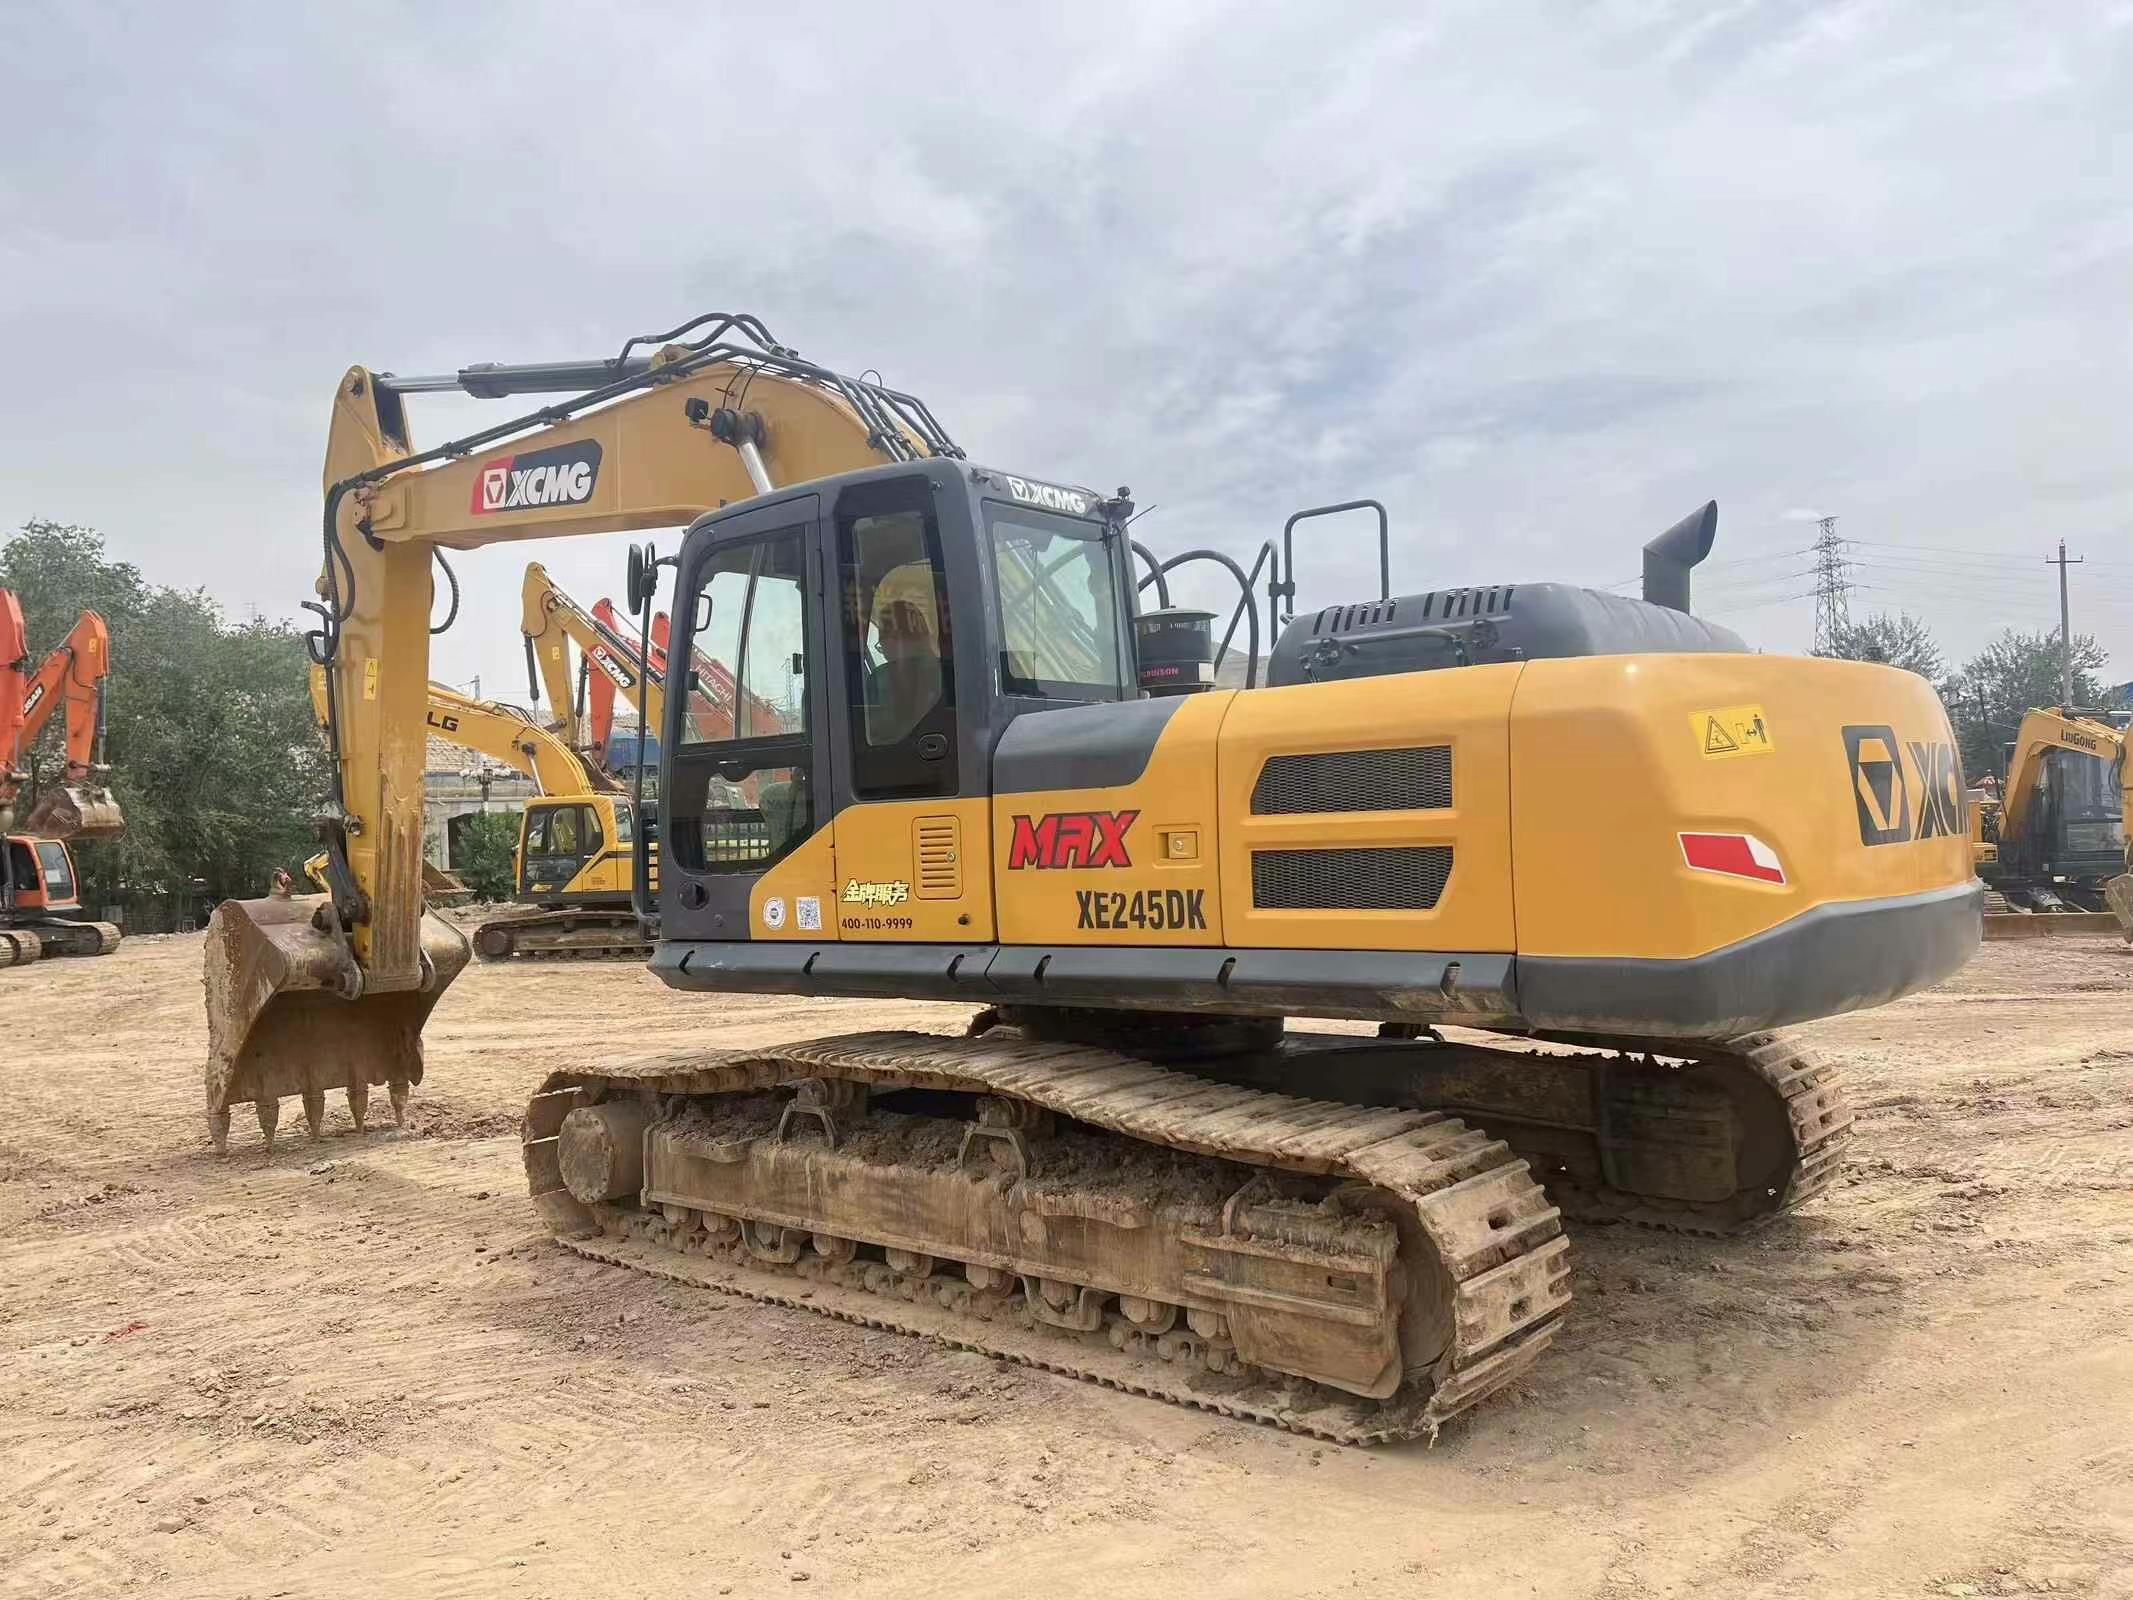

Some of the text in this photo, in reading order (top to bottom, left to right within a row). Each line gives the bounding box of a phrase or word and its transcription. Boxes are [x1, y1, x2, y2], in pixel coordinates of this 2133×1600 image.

[506, 461, 591, 507] XCMG
[1028, 482, 1086, 513] XCMG
[600, 656, 631, 687] XCMG
[695, 664, 733, 701] HITACHI
[1008, 810, 1141, 870] MAX
[842, 879, 910, 908] 金牌服务
[1076, 889, 1207, 930] XE245DK
[841, 917, 913, 930] 400-110-9999
